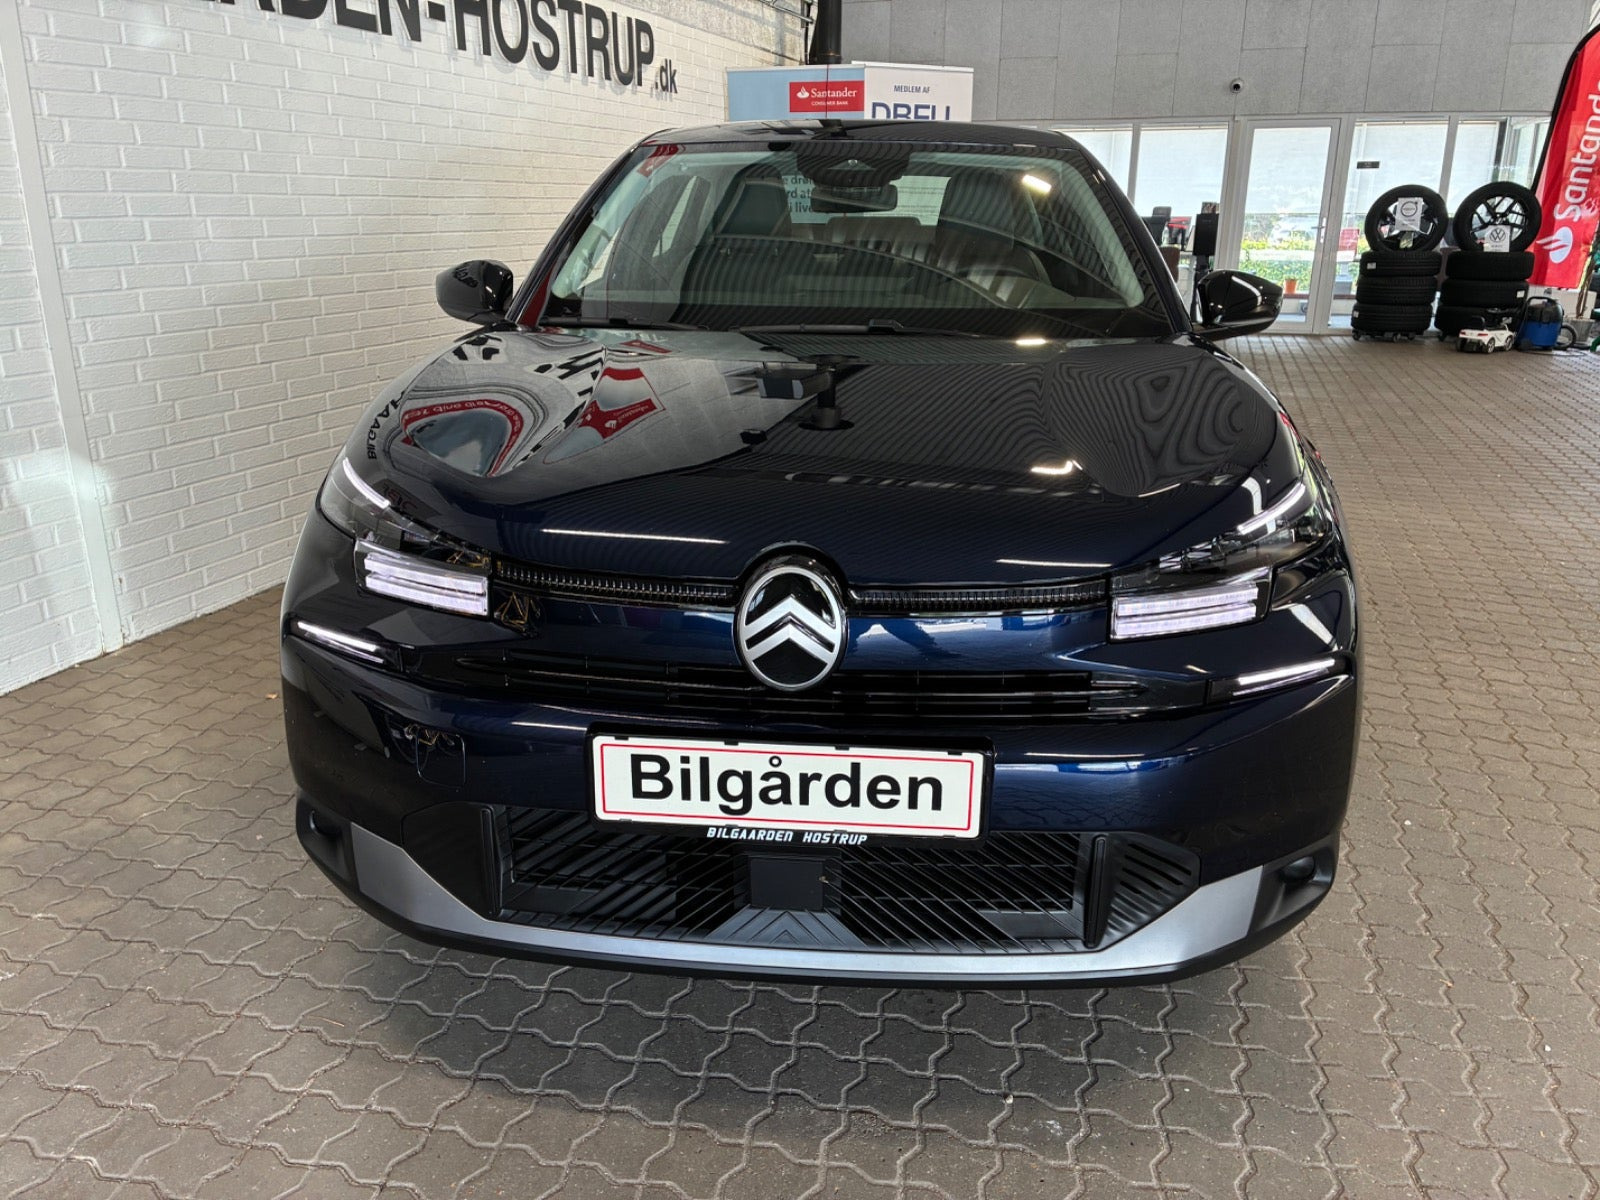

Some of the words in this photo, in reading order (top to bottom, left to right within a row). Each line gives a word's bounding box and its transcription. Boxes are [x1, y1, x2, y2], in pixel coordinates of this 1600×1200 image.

[811, 86, 857, 98] Santander
[894, 84, 921, 93] MEDLEM
[922, 86, 931, 94] AF
[1553, 80, 1600, 222] Santand
[630, 753, 943, 816] Bilgården
[706, 826, 794, 843] BILGAARDEN
[802, 831, 868, 845] HOSTRUP
